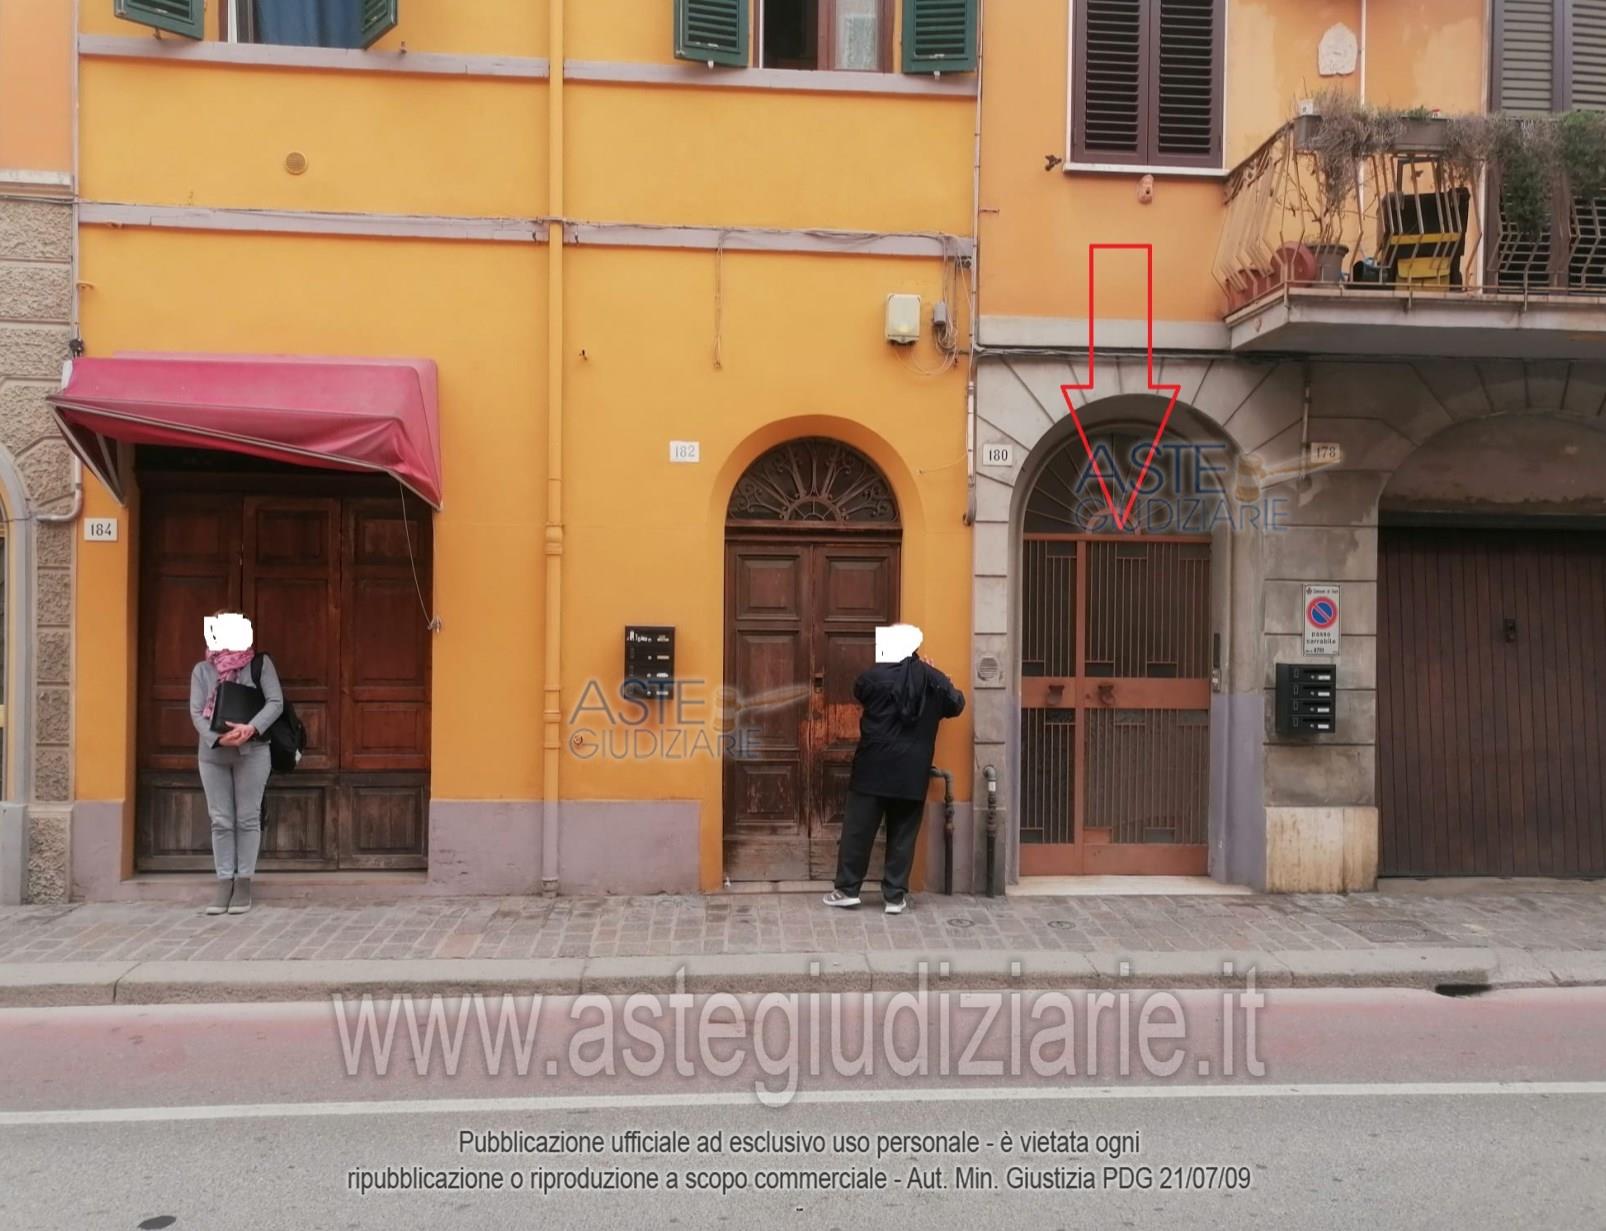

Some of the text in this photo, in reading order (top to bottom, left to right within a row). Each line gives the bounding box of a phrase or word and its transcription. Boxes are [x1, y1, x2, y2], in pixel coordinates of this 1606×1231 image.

[674, 444, 696, 458] 182
[989, 449, 1008, 461] 180
[1317, 446, 1336, 459] 178
[91, 522, 112, 537] 184
